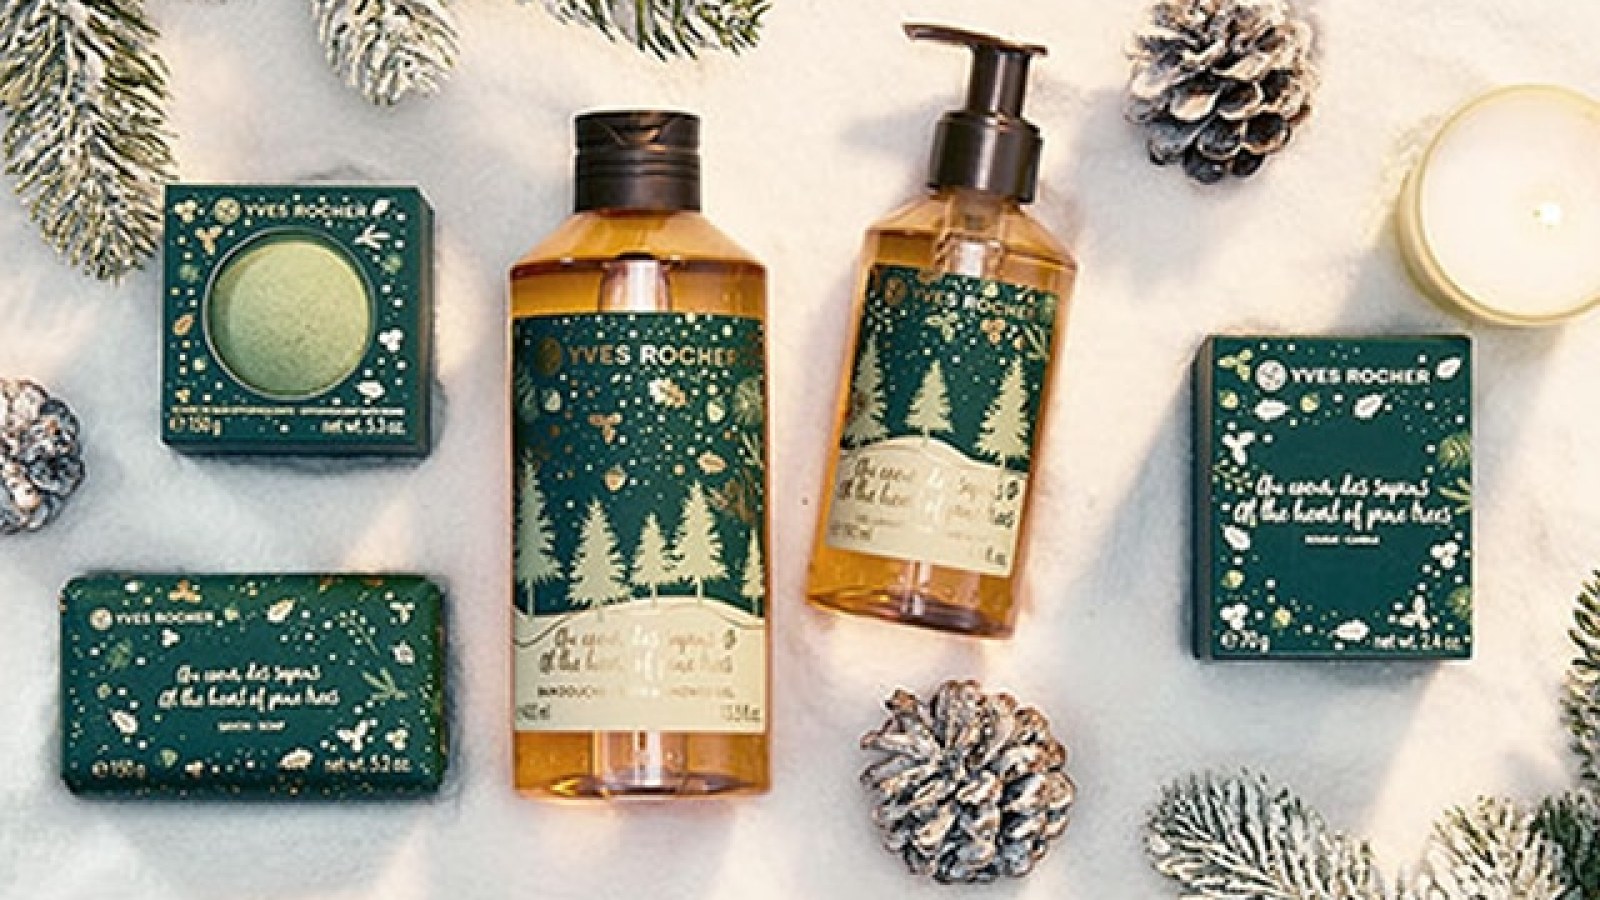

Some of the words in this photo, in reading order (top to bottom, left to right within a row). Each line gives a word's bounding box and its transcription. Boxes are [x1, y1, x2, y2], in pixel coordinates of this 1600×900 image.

[245, 203, 288, 218] YVES
[293, 203, 367, 219] ROCHER
[568, 344, 630, 366] YVES
[1290, 368, 1341, 385] YVES
[1344, 368, 1431, 385] ROCHER
[1339, 473, 1370, 496] des
[1260, 496, 1289, 523] the
[1293, 497, 1341, 524] heart
[1343, 499, 1364, 531] of
[1366, 507, 1406, 531] pine
[1411, 499, 1451, 524] trees
[116, 611, 151, 624] YVES
[154, 611, 214, 624] ROCHER
[180, 686, 205, 707] the
[207, 685, 248, 707] heart
